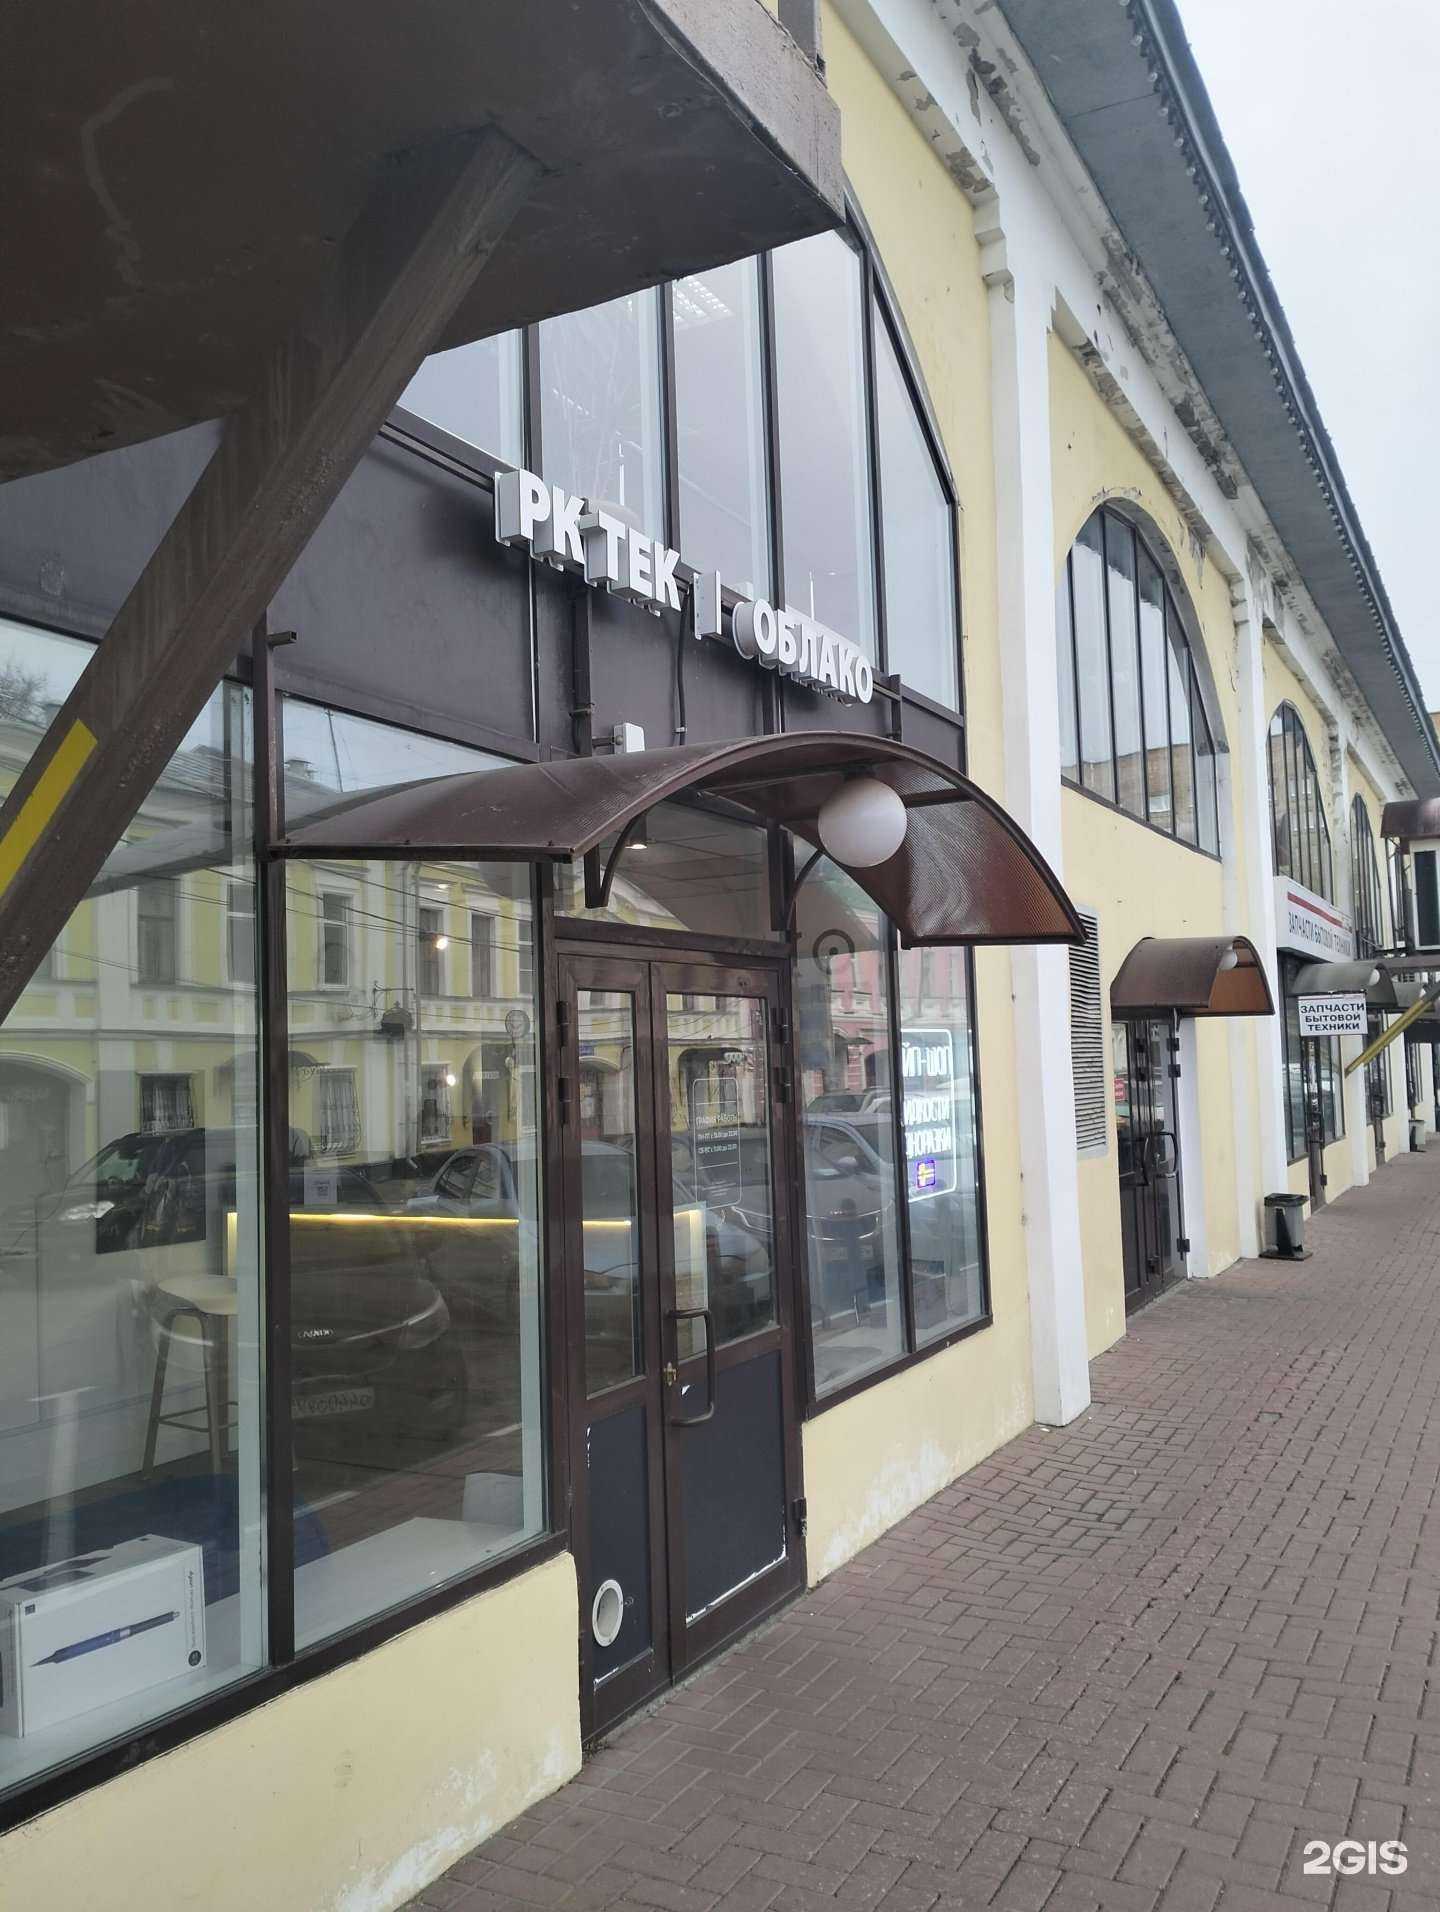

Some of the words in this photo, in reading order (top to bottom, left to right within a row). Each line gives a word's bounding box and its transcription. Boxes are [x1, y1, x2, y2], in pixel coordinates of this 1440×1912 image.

[752, 598, 873, 704] ОБЛАКО
[1300, 1003, 1365, 1014] ЗАПЧАСТИ
[1308, 1023, 1360, 1032] ТЕХНИКИ
[901, 1043, 951, 1077] ЙП-ШОП
